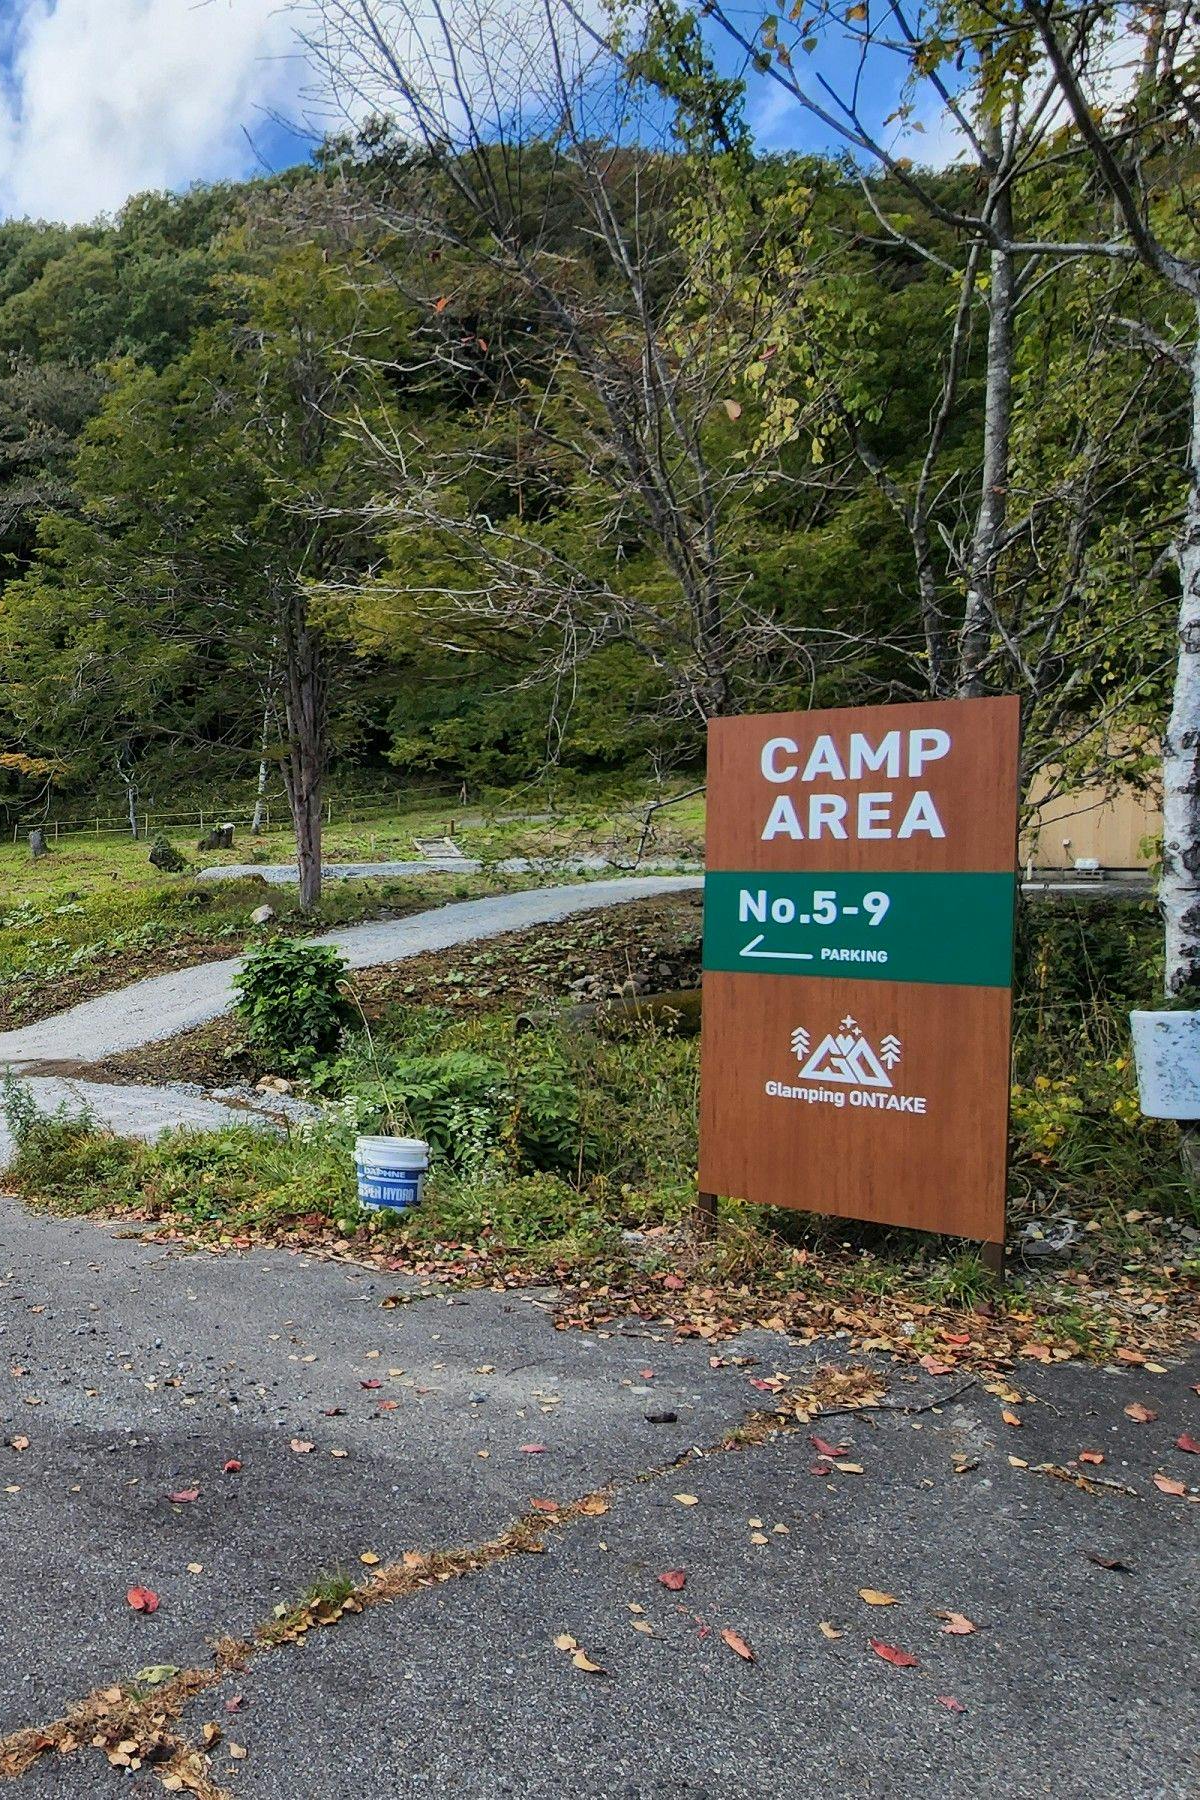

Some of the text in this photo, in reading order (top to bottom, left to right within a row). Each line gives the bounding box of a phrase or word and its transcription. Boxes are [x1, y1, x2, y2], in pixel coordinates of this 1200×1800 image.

[761, 728, 951, 783] CAMP
[761, 791, 946, 840] AREA
[739, 889, 891, 926] No.5-9
[821, 947, 888, 963] PARKING
[765, 1080, 927, 1114] Glamping ONTAKE
[364, 1166, 406, 1178] DAPHNE
